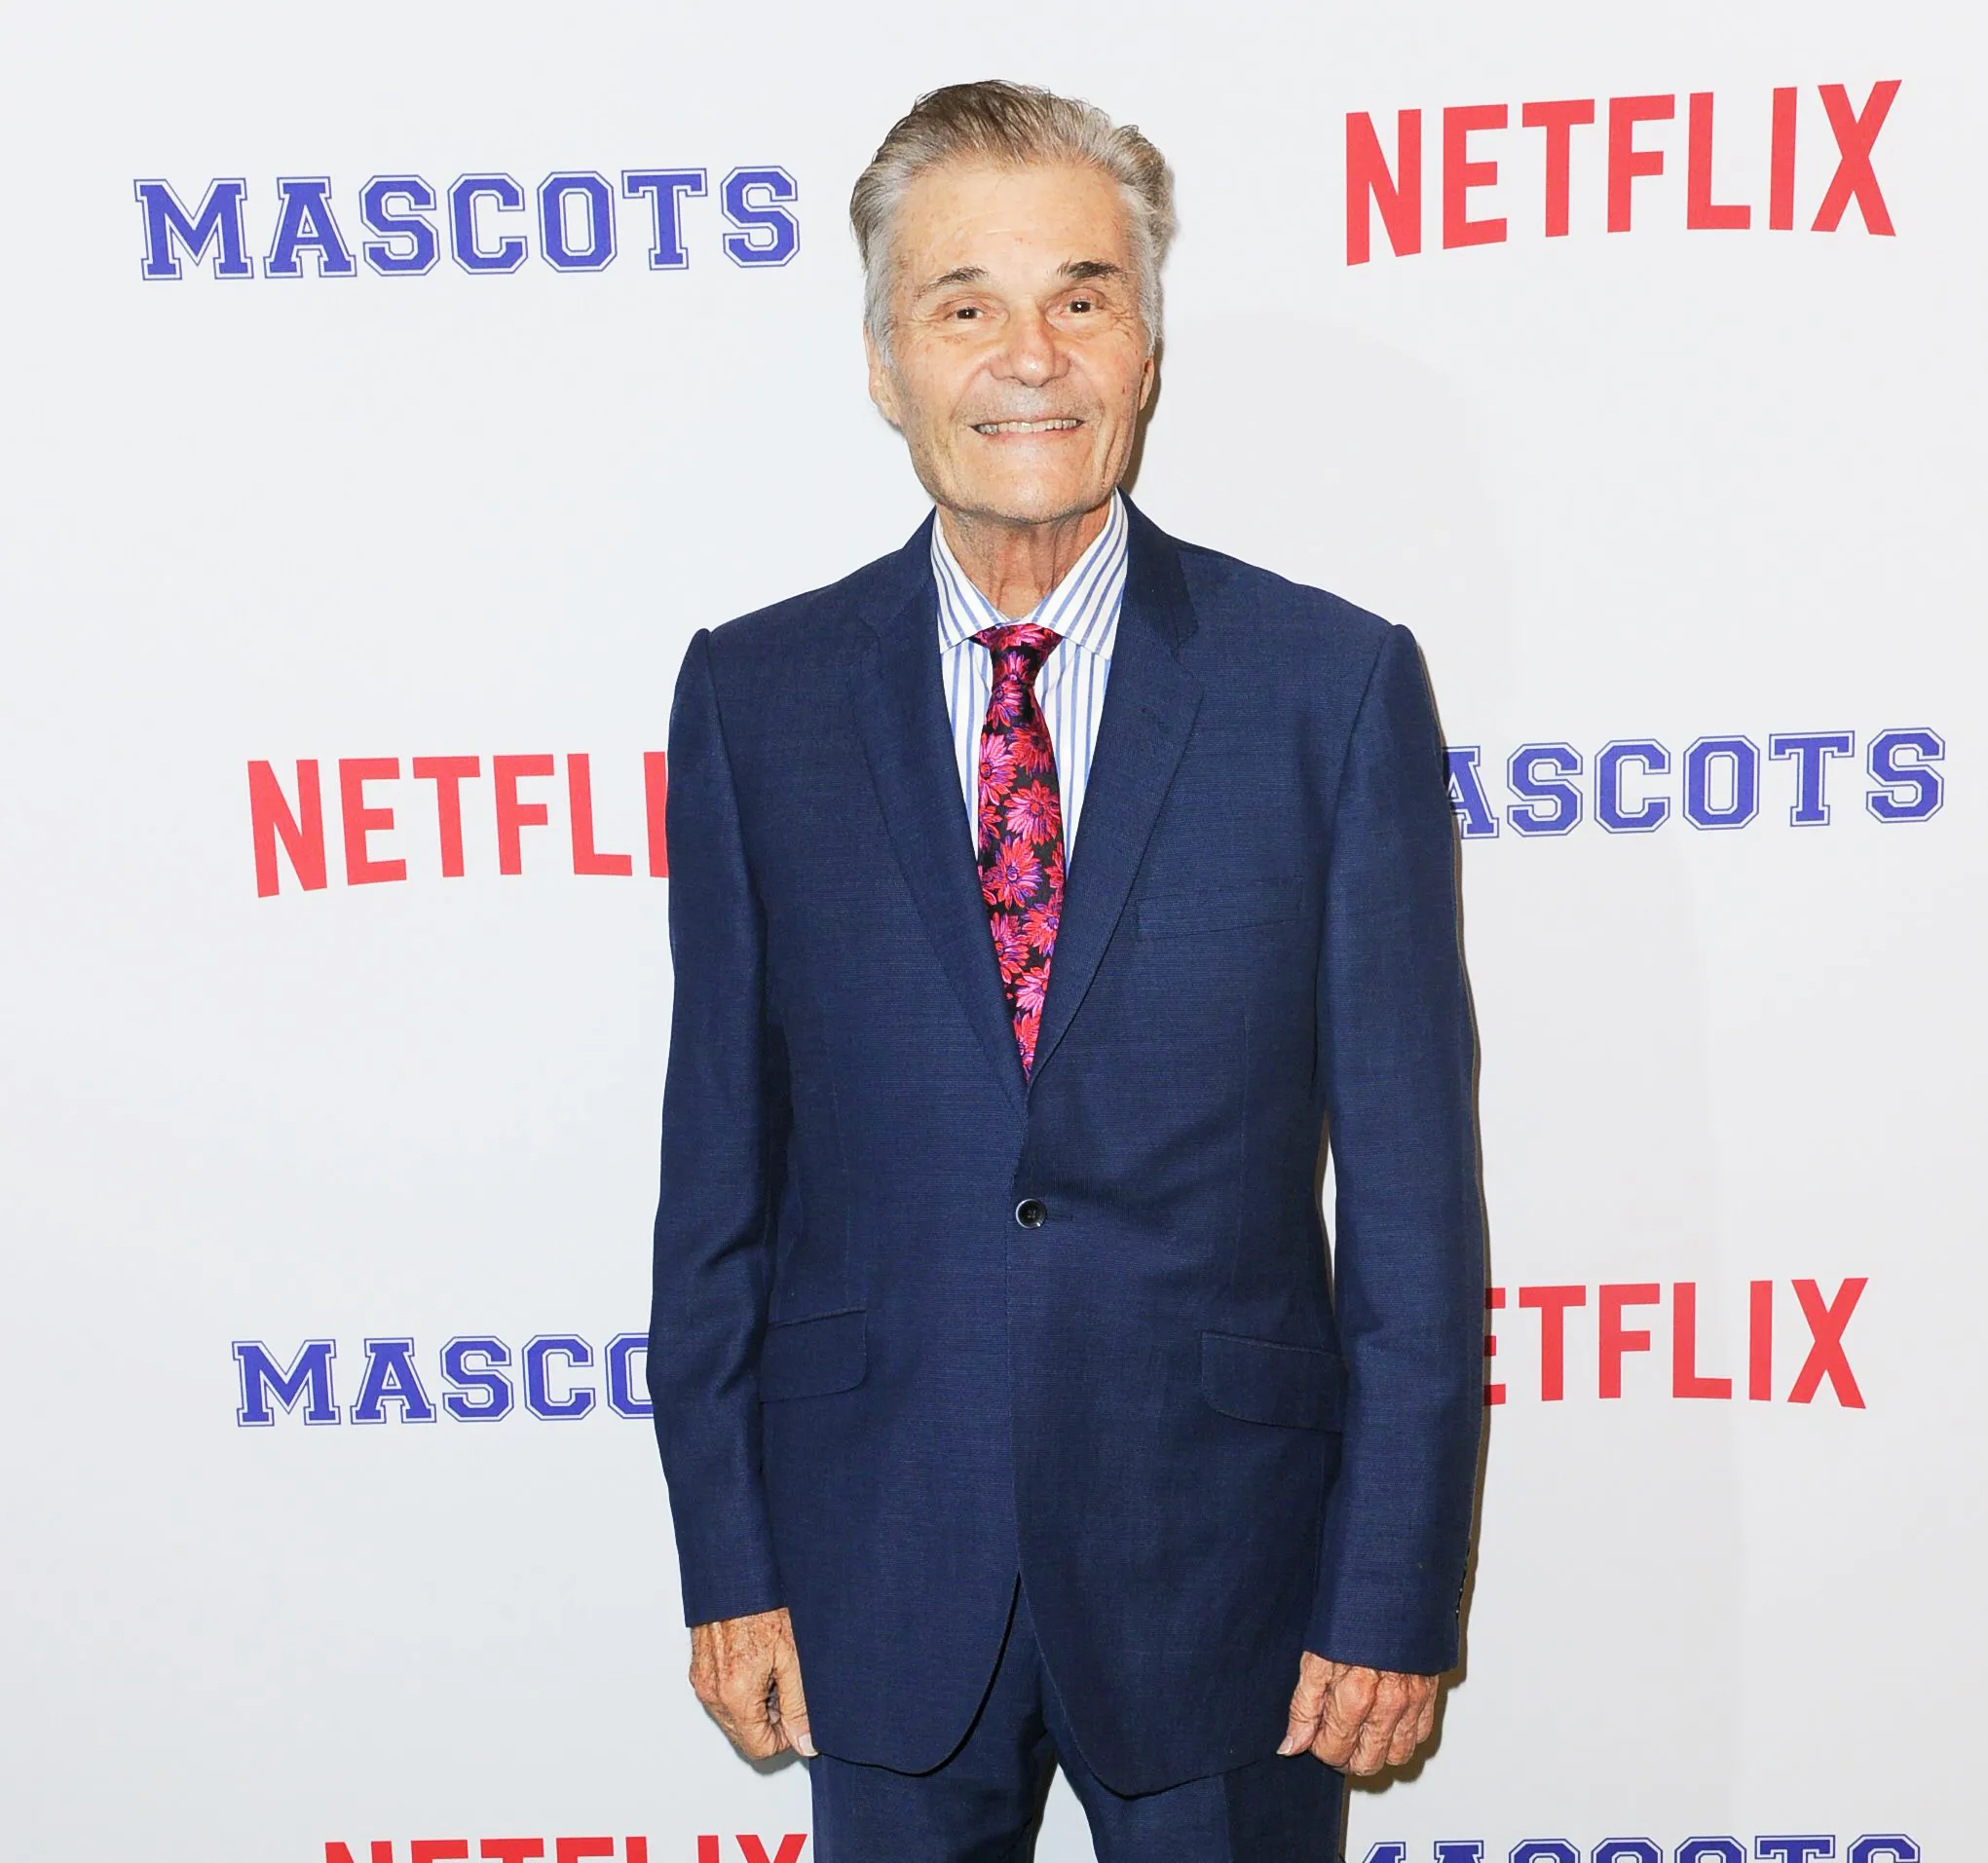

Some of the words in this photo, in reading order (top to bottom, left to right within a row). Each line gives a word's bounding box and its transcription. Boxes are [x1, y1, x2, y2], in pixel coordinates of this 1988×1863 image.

[133, 166, 800, 281] MASCOTS
[1344, 80, 1902, 266] NETFLIX
[247, 751, 669, 898] NETFLI
